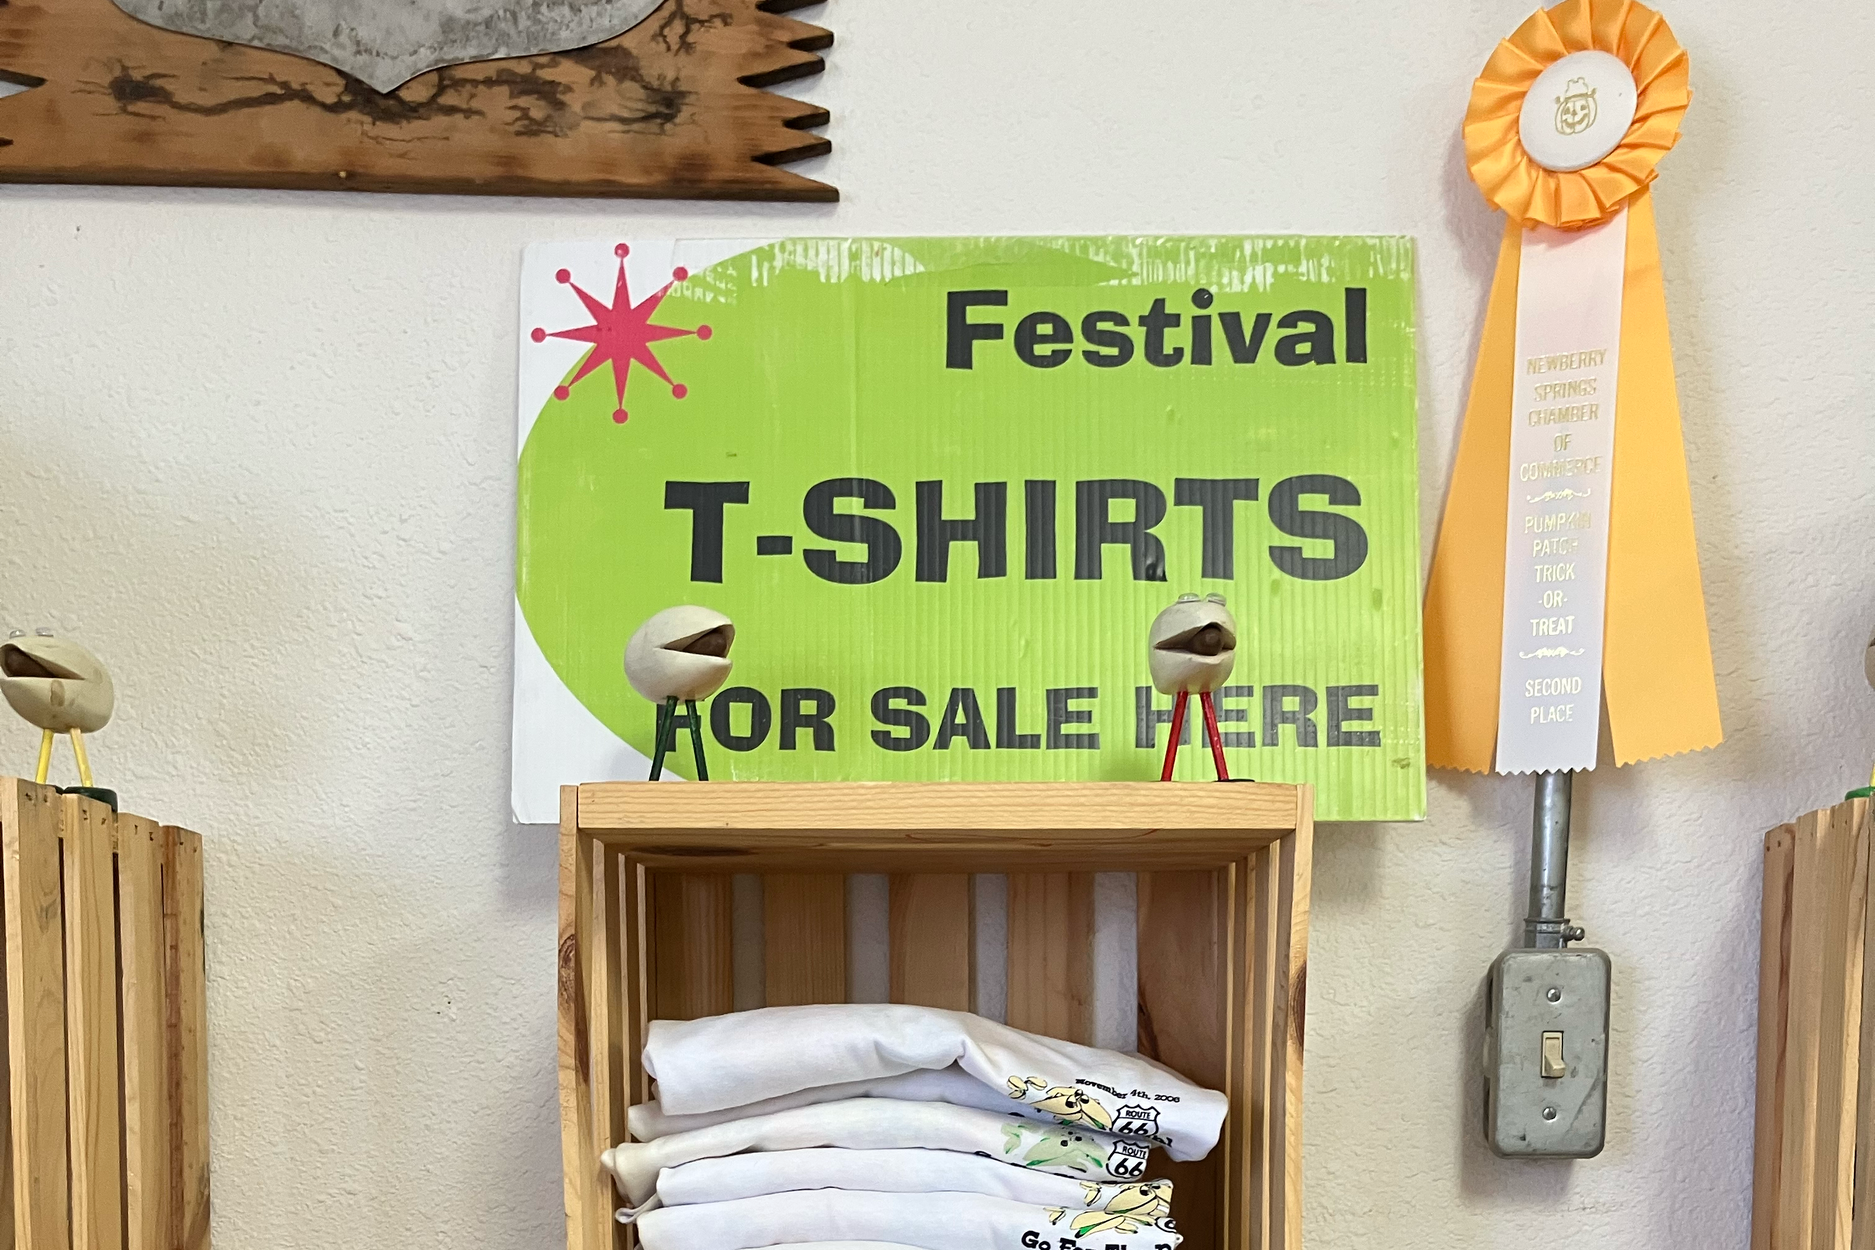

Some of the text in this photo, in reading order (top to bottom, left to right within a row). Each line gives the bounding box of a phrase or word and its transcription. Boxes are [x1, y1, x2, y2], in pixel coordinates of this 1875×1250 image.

[945, 286, 1368, 369] Festival
[1527, 348, 1607, 375] NEWBERRY
[1534, 377, 1597, 402] SPRINGS
[1528, 403, 1599, 427] CHAMBER
[1553, 433, 1573, 452] OF
[1520, 456, 1602, 482] COMMERCE
[664, 473, 1370, 585] T-SHIRTS
[1524, 510, 1591, 534] PUMPKIN
[1534, 563, 1576, 582] TRICK
[1530, 615, 1575, 637] TREAT
[1524, 676, 1582, 698] SECOND
[870, 685, 1101, 752] SALE
[1135, 684, 1381, 750] HERE
[1530, 704, 1575, 725] PLACE
[1075, 1078, 1128, 1100] November
[1125, 1109, 1151, 1120] ROUTE
[1118, 1120, 1149, 1135] 66
[1114, 1157, 1144, 1177] 66
[1021, 1230, 1051, 1250] Go
